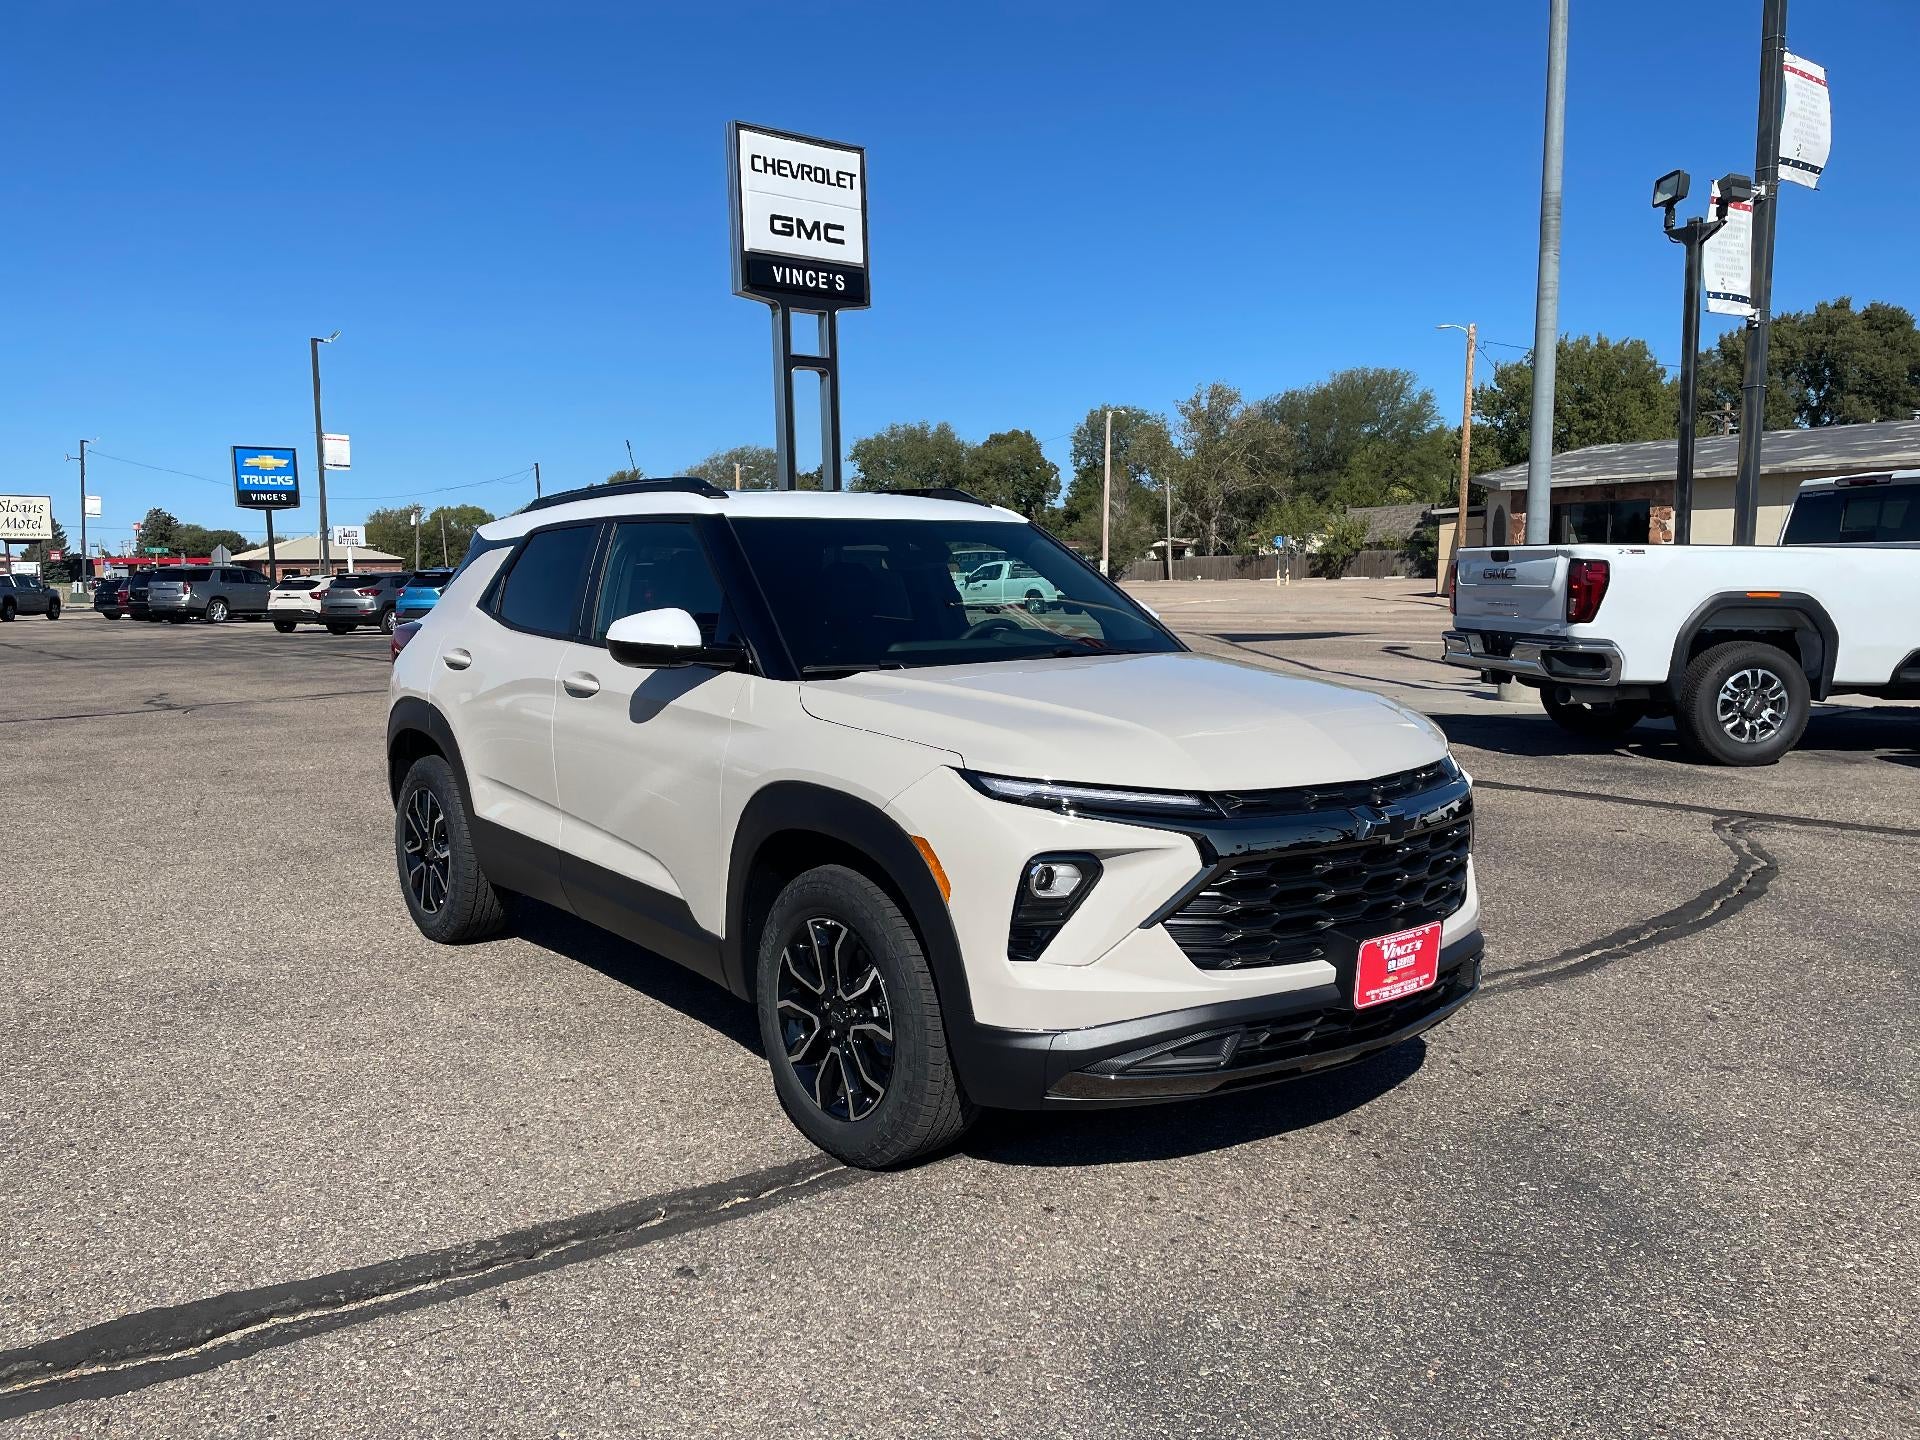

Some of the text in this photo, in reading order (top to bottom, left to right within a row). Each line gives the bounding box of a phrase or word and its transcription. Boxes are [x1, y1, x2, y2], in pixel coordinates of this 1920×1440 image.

[751, 153, 856, 190] CHEVROLET
[769, 213, 845, 245] GMC
[772, 265, 845, 291] VINCE'S
[240, 474, 294, 486] TRUCKS
[251, 493, 287, 501] VINCE'S
[0, 499, 44, 514] Sloans
[0, 515, 42, 530] Motel
[1483, 567, 1517, 580] GMC
